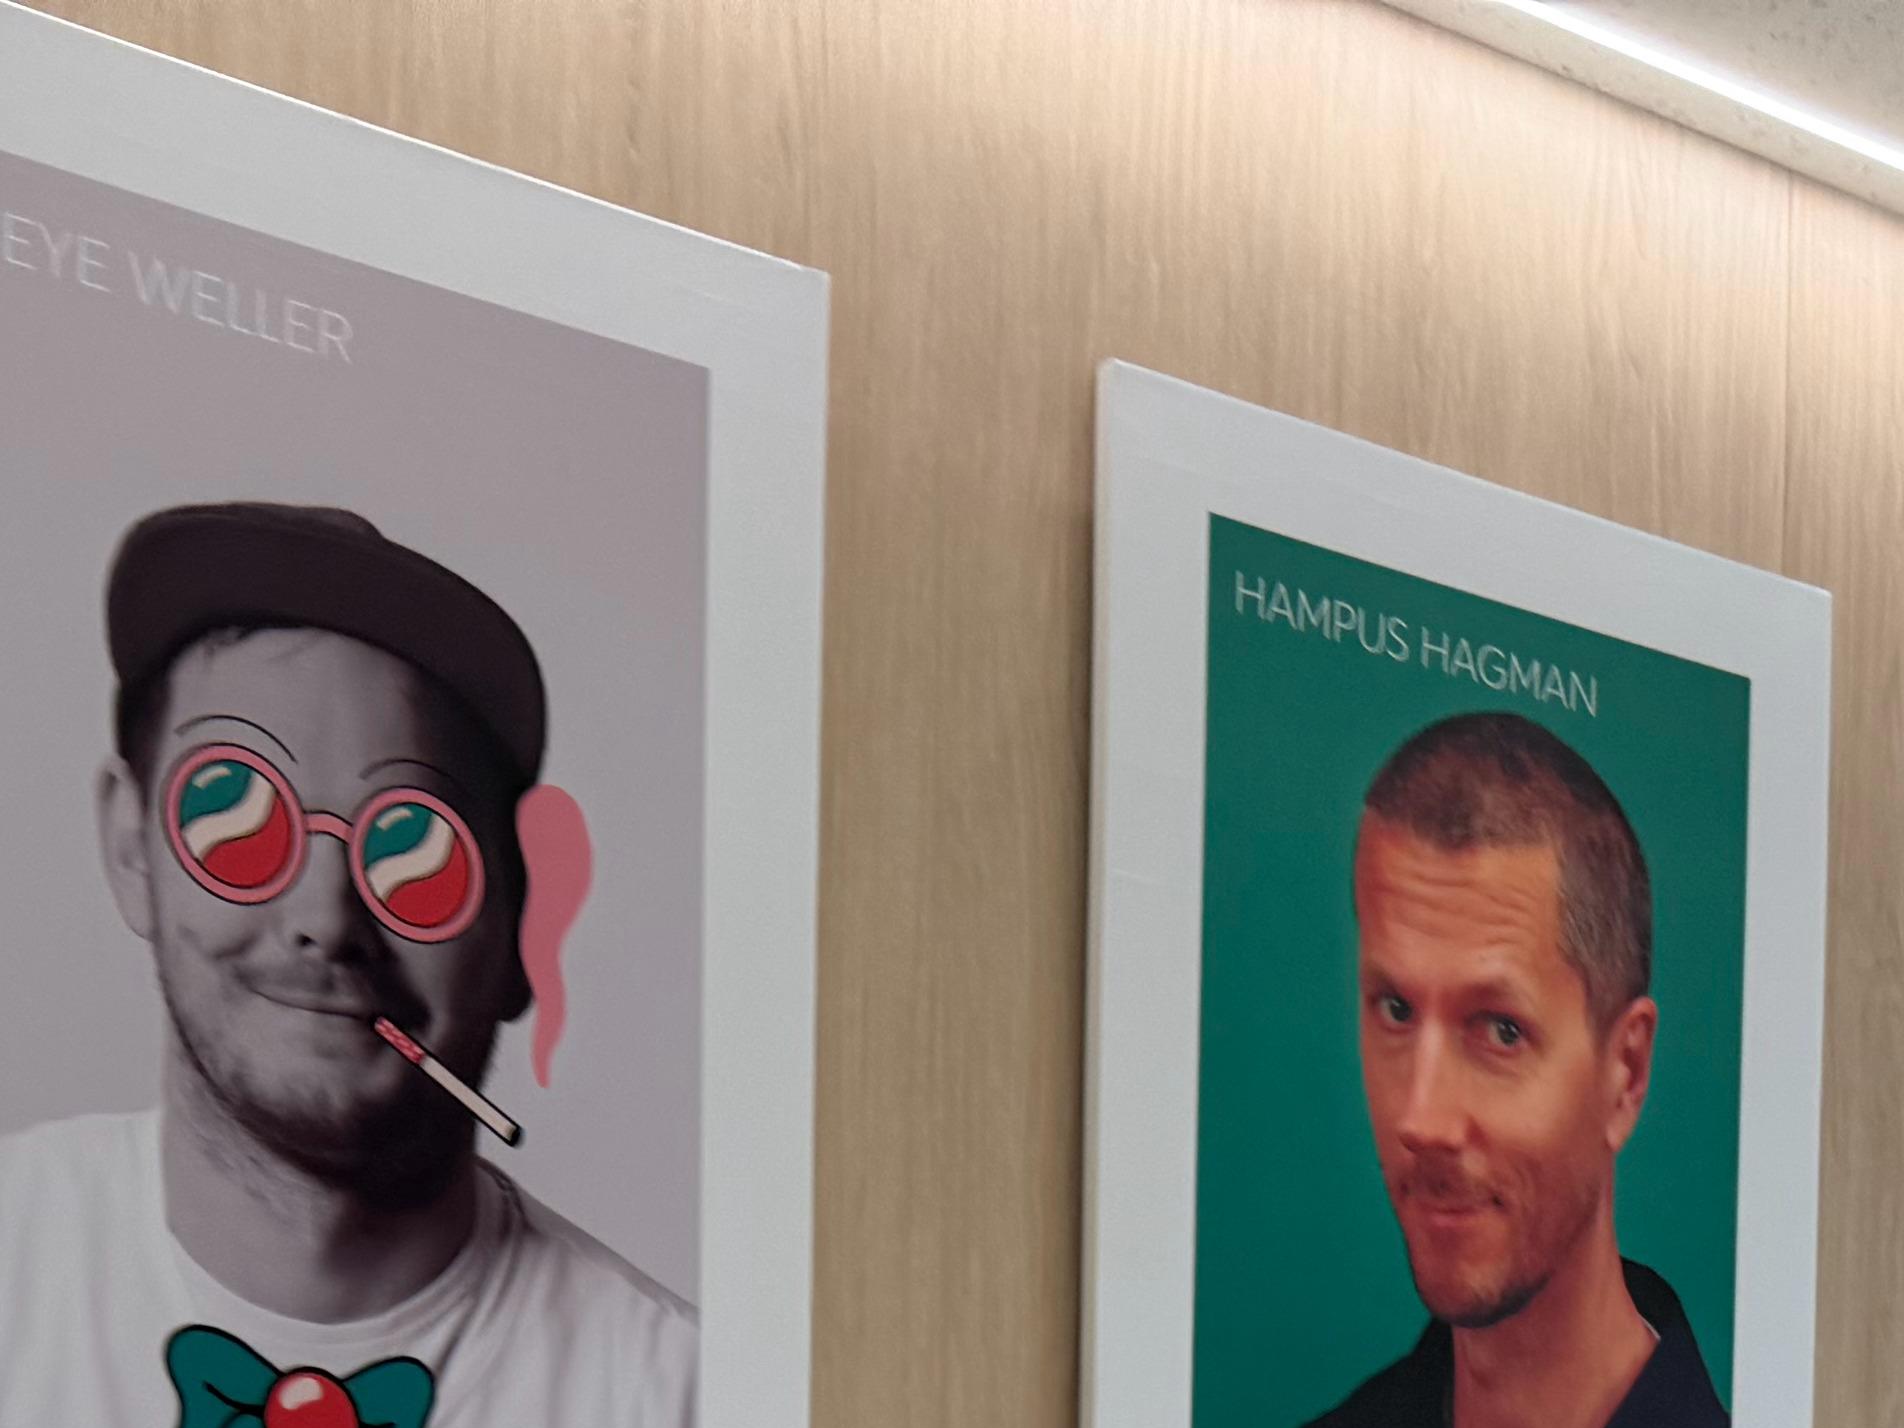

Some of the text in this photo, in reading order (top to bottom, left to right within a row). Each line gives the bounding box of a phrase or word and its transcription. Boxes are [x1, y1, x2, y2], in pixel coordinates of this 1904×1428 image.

[127, 250, 355, 365] WELLER
[1235, 570, 1597, 717] HAMPUS HAGMAN
